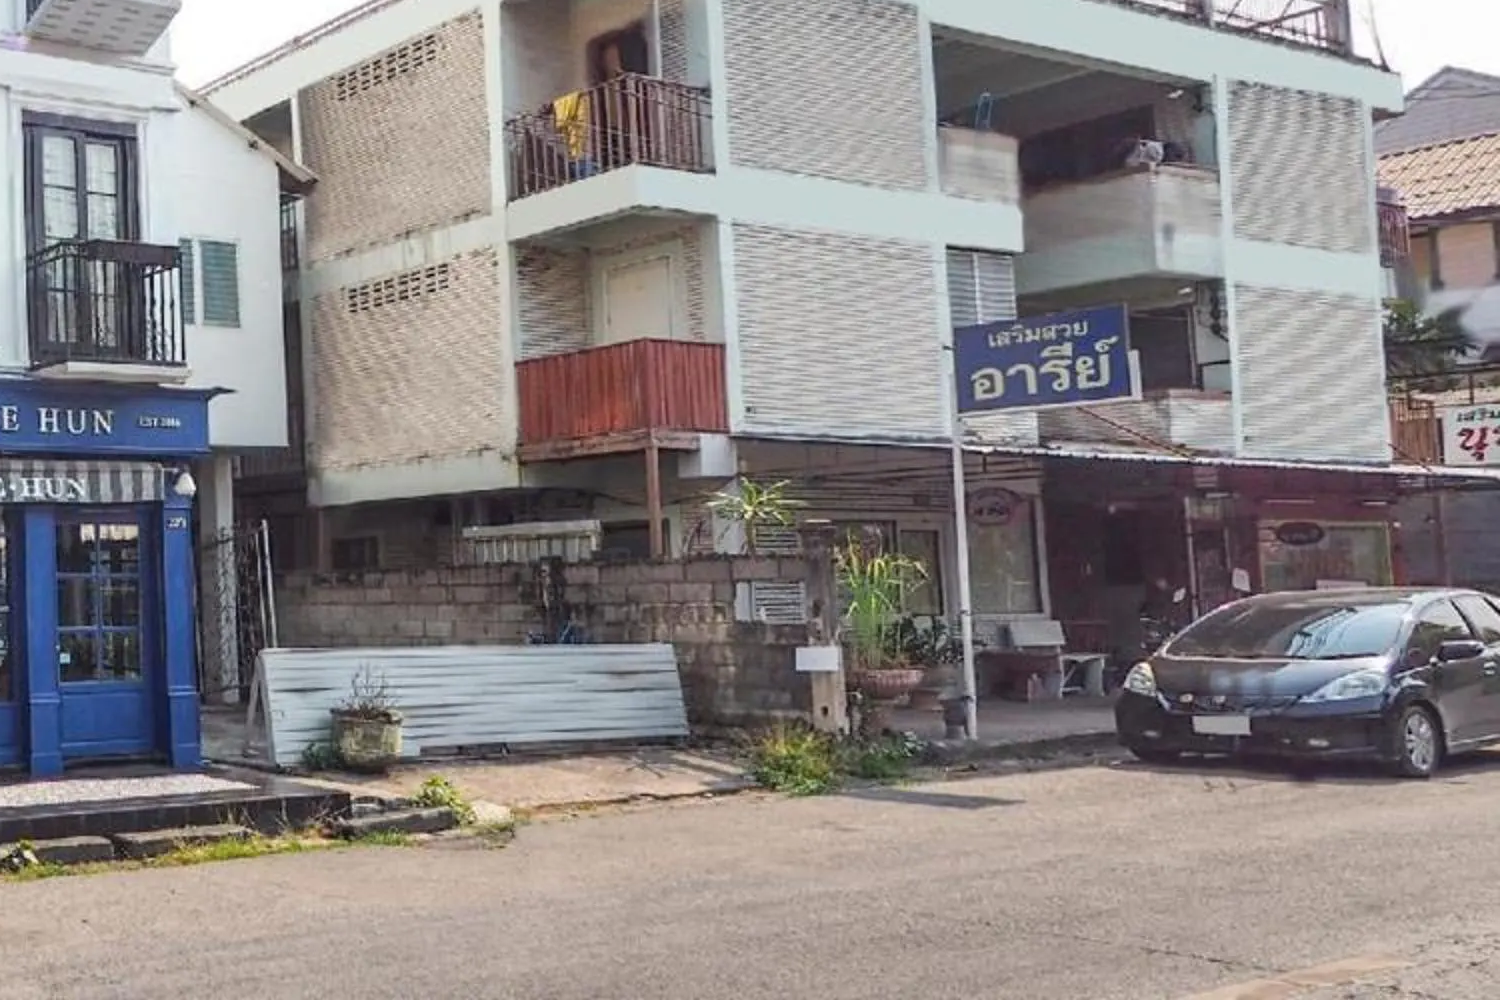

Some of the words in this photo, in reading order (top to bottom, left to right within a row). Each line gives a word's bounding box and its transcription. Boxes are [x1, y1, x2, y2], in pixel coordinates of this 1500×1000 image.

[971, 335, 1119, 400] อารีย์
[37, 406, 116, 435] HUN
[19, 477, 88, 499] HUN
